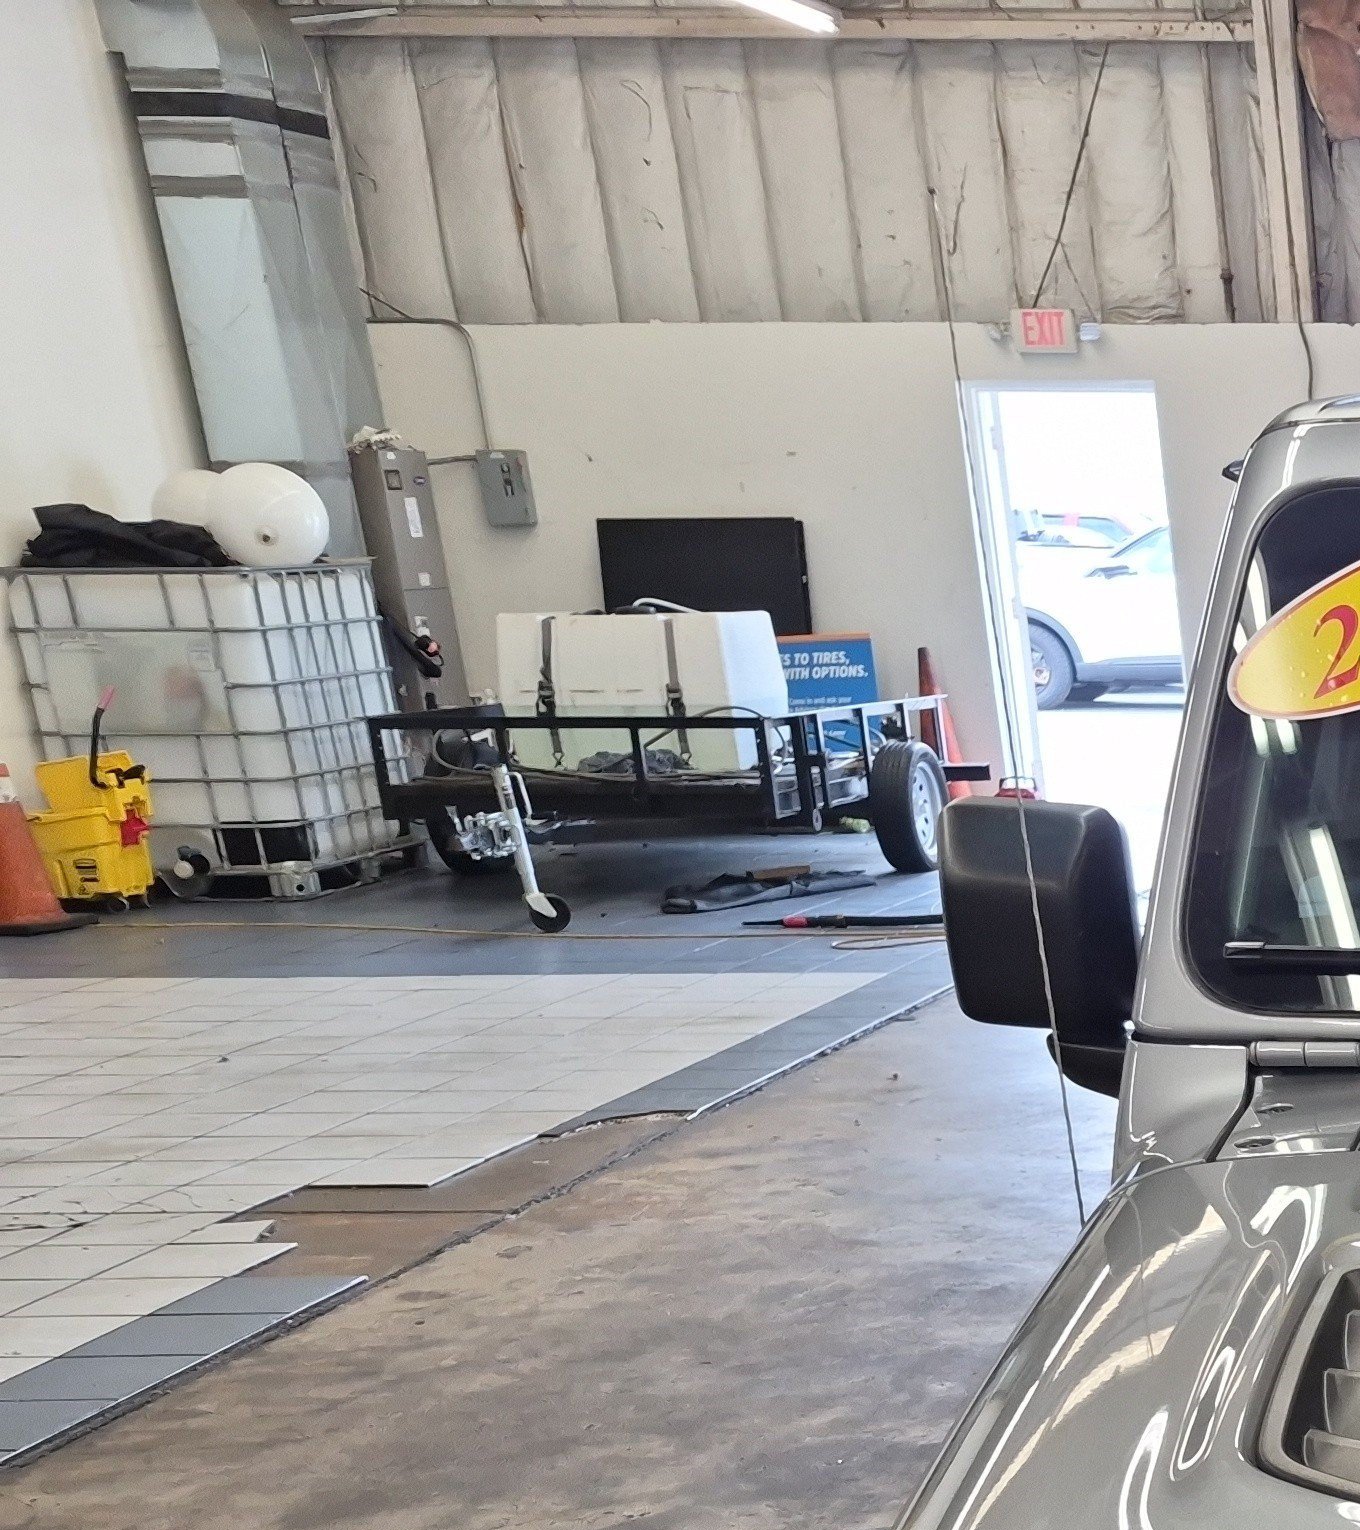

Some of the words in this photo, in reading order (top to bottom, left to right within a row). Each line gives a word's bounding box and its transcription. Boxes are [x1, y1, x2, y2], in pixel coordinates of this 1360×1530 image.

[1021, 311, 1065, 346] EXIT
[793, 652, 809, 665] TO
[812, 651, 850, 665] TIRES,
[812, 665, 868, 679] OPTIONS.
